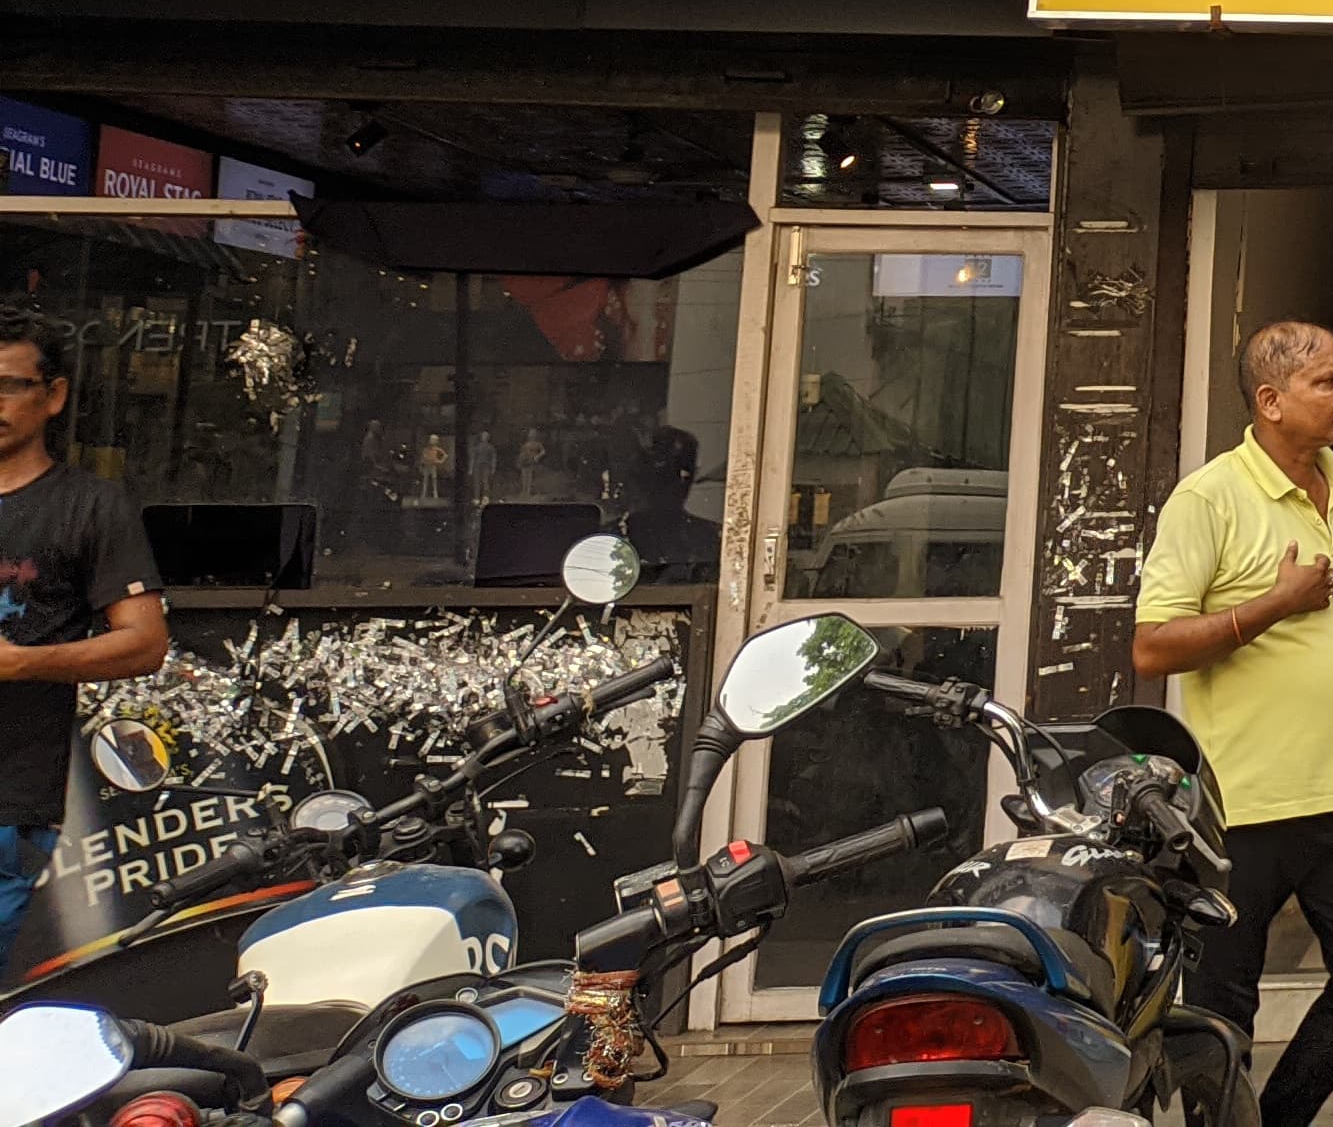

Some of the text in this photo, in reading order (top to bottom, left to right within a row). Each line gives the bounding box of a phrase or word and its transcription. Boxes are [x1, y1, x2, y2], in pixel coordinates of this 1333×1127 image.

[2, 147, 77, 186] IAL BLUE
[35, 784, 293, 889] LENDERS
